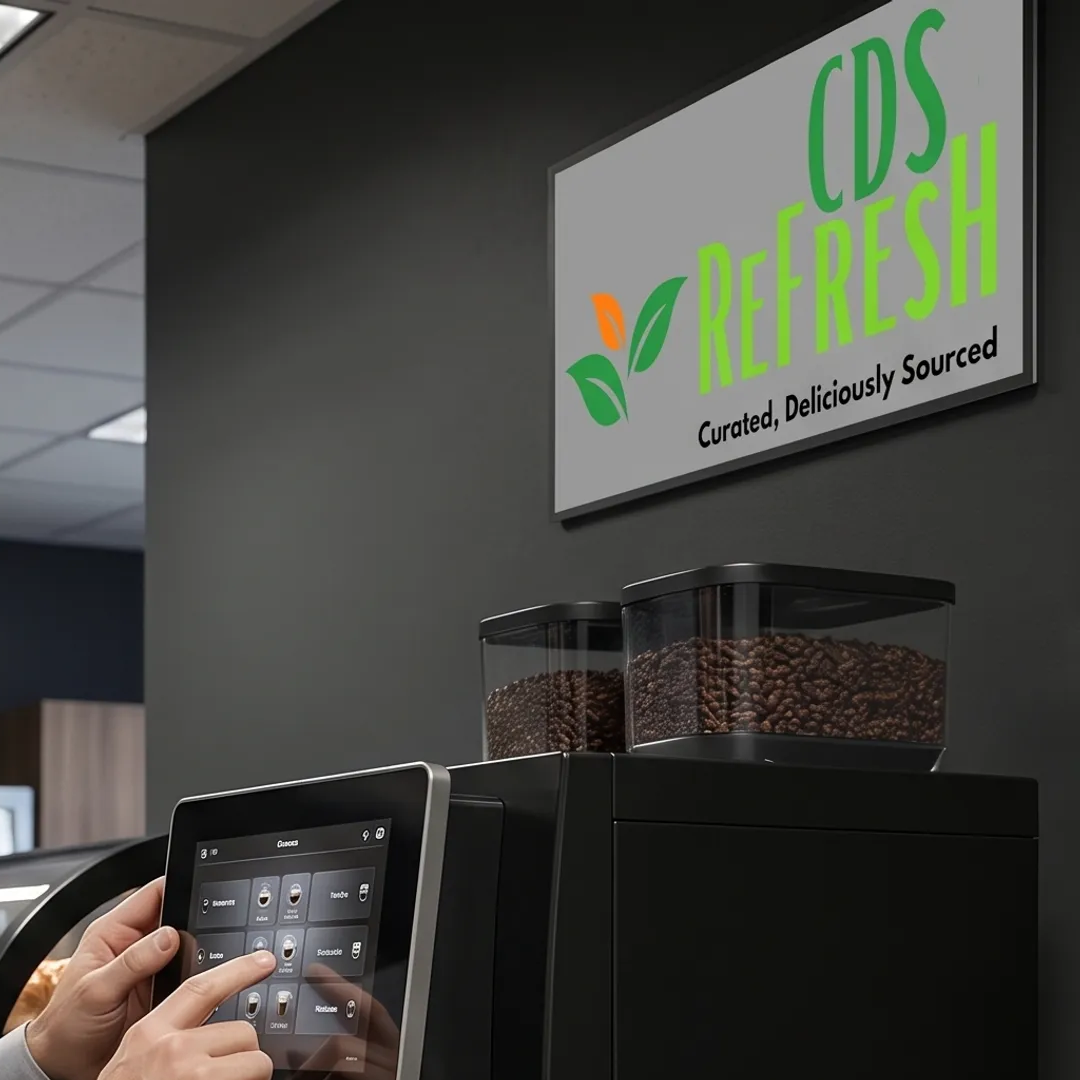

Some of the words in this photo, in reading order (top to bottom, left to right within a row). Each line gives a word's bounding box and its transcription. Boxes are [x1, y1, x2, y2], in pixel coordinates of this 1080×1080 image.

[808, 8, 947, 214] CDS
[698, 401, 780, 448] Curated,
[785, 364, 896, 423] Deliciously
[902, 325, 998, 386] Sourced
